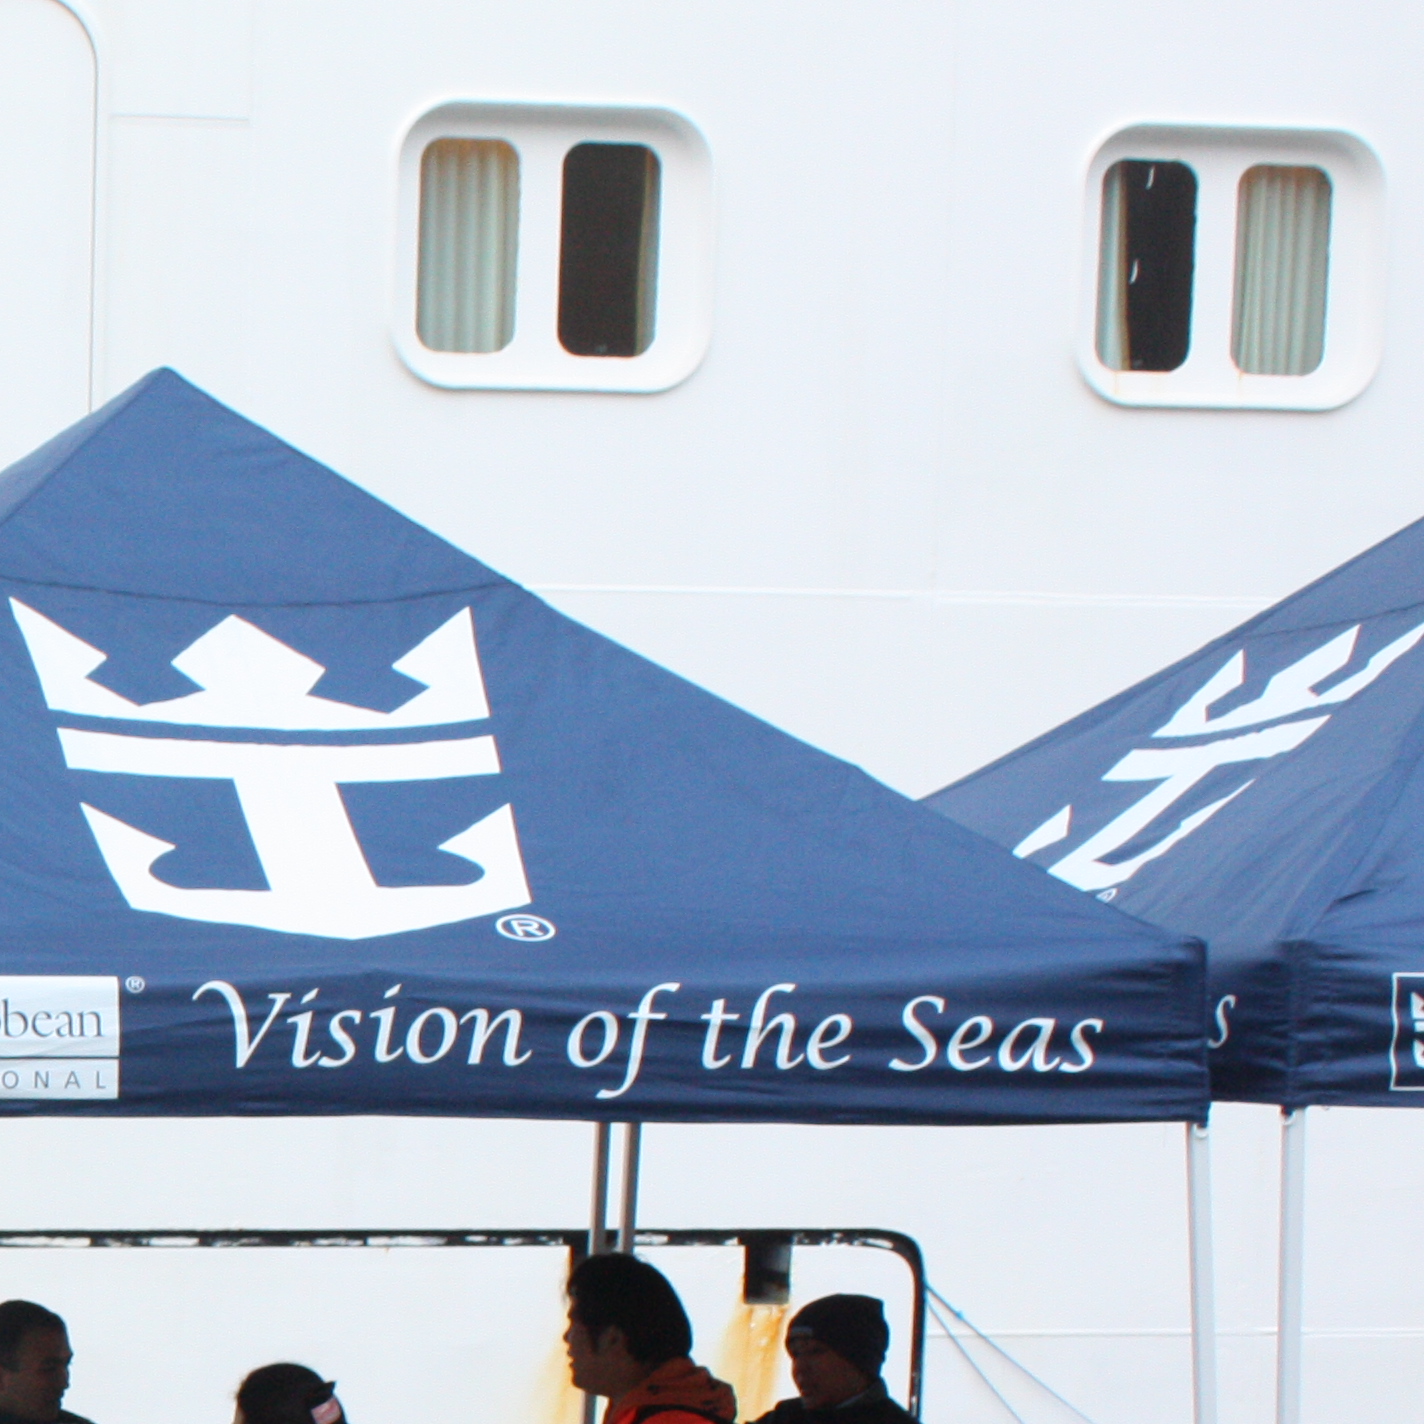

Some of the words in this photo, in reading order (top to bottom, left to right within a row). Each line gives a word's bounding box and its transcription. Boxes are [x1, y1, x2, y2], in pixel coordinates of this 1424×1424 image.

[191, 980, 533, 1069] Vision
[566, 982, 681, 1100] of
[700, 983, 853, 1071] the
[888, 995, 1105, 1074] Seas
